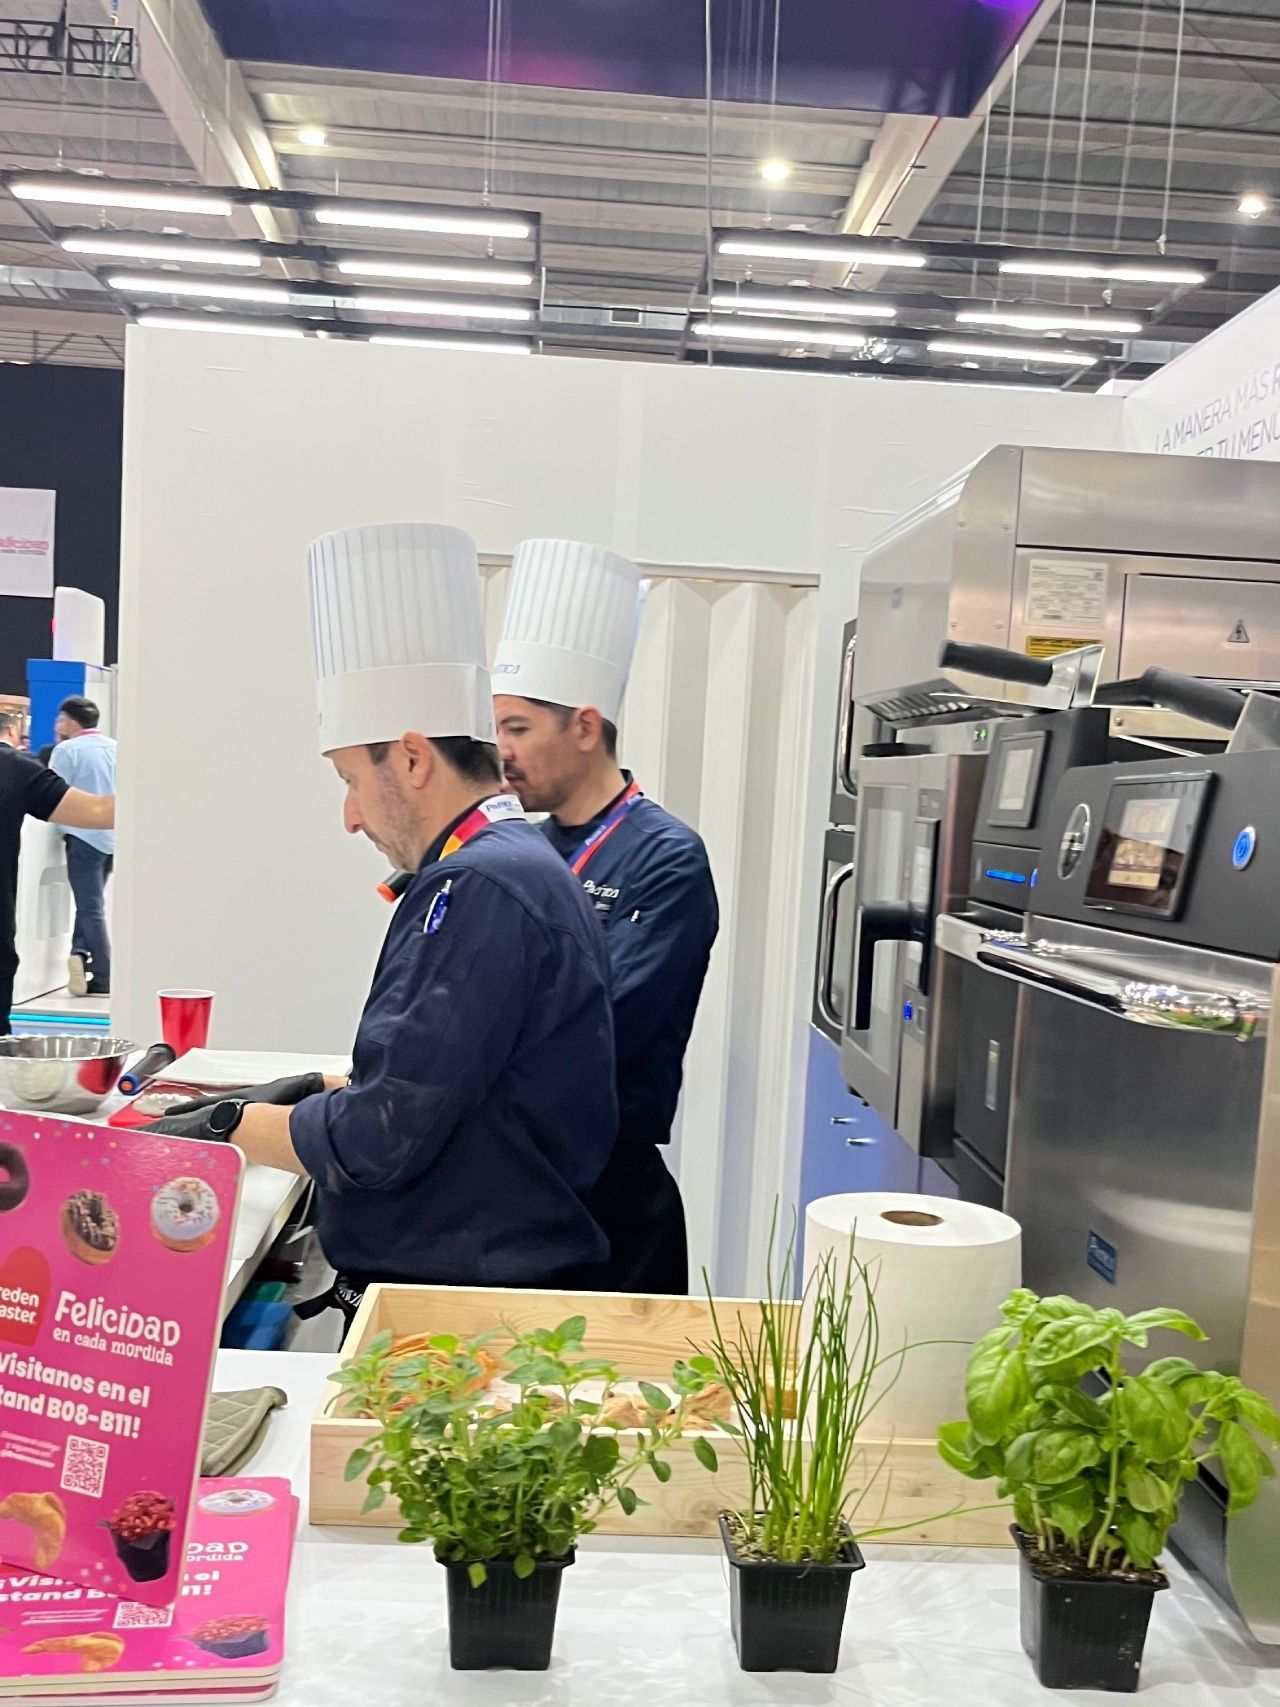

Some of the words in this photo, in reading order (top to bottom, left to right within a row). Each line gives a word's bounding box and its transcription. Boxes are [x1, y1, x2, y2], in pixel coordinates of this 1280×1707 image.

[1173, 394, 1232, 449] MANERA
[0, 1304, 37, 1324] aster
[53, 1326, 71, 1343] en
[74, 1332, 107, 1351] cada
[111, 1340, 174, 1367] mordida
[98, 1380, 126, 1403] en
[128, 1385, 151, 1408] el
[46, 1396, 141, 1439] B08-B11!
[186, 1553, 244, 1562] ordida
